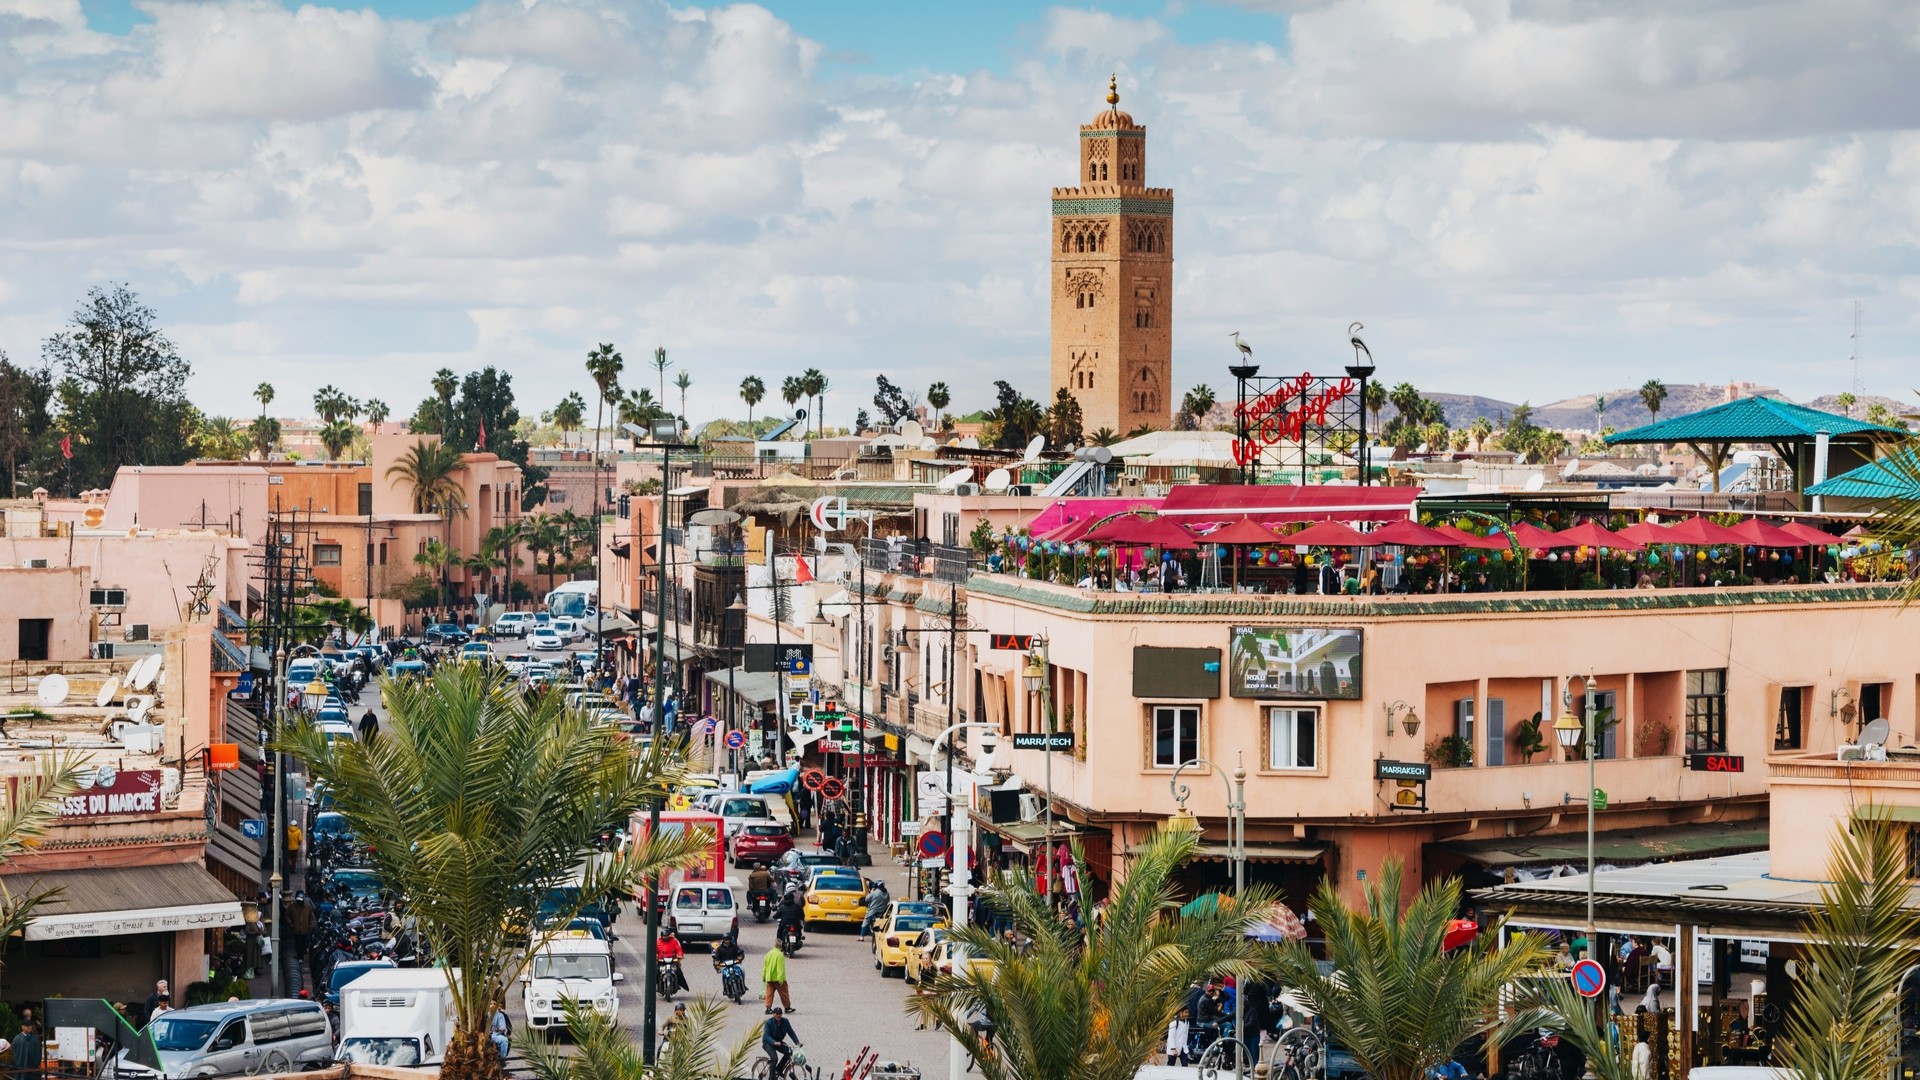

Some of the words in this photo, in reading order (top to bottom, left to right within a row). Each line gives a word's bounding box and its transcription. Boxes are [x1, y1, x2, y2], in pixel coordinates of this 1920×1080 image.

[1233, 371, 1314, 430] Terrasse
[1261, 376, 1355, 445] Cigogne
[996, 635, 1020, 649] LA
[1381, 766, 1425, 775] MARRAKECH
[88, 795, 107, 815] DU
